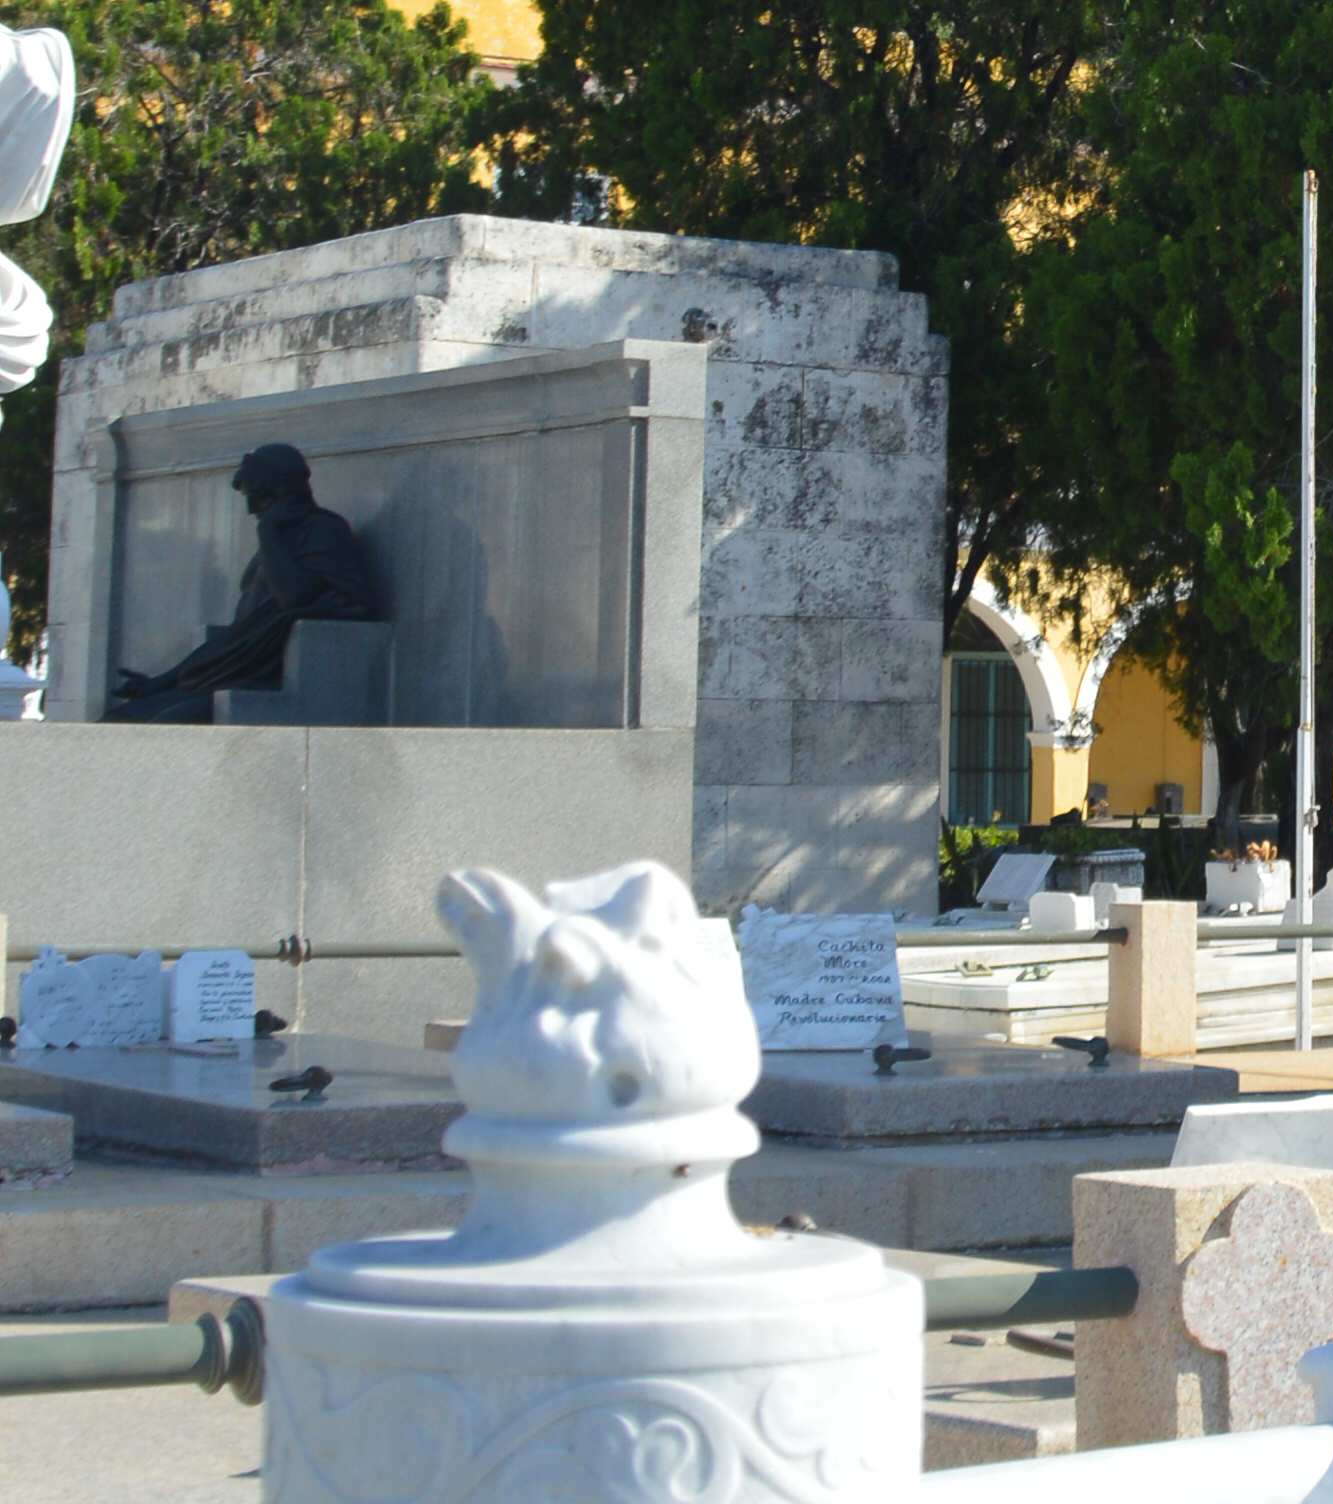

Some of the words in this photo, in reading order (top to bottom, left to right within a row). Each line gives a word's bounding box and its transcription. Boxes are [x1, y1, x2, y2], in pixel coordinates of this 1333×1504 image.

[818, 939, 885, 953] Cachita
[773, 993, 825, 1006] Madre
[835, 993, 894, 1005] Cubana
[779, 1011, 887, 1026] Revolucionaria
